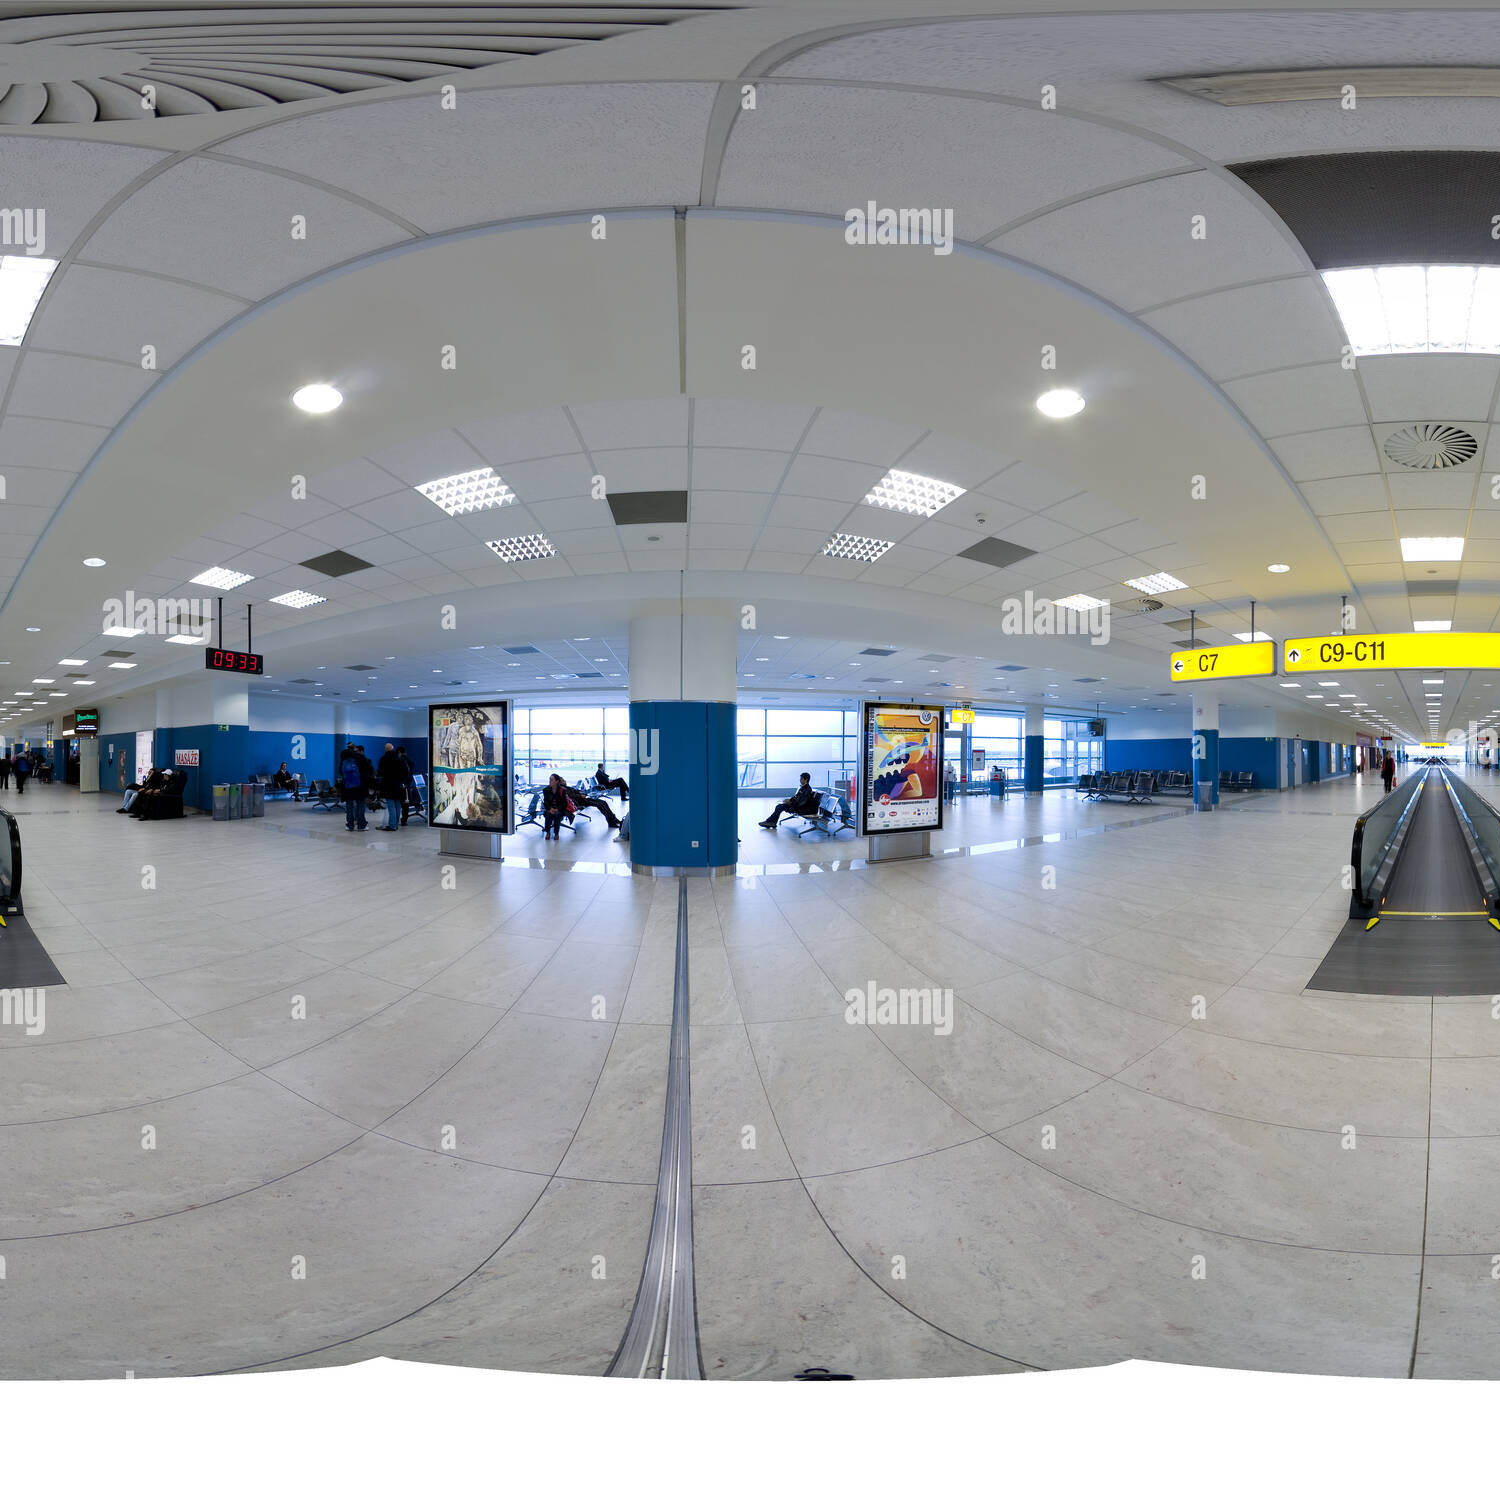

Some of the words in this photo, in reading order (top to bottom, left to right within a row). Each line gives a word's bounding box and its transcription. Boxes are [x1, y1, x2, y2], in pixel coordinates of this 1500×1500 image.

[214, 651, 257, 671] 09:33
[1320, 641, 1385, 663] C9-C11
[1198, 654, 1219, 672] C7
[962, 712, 973, 722] C7
